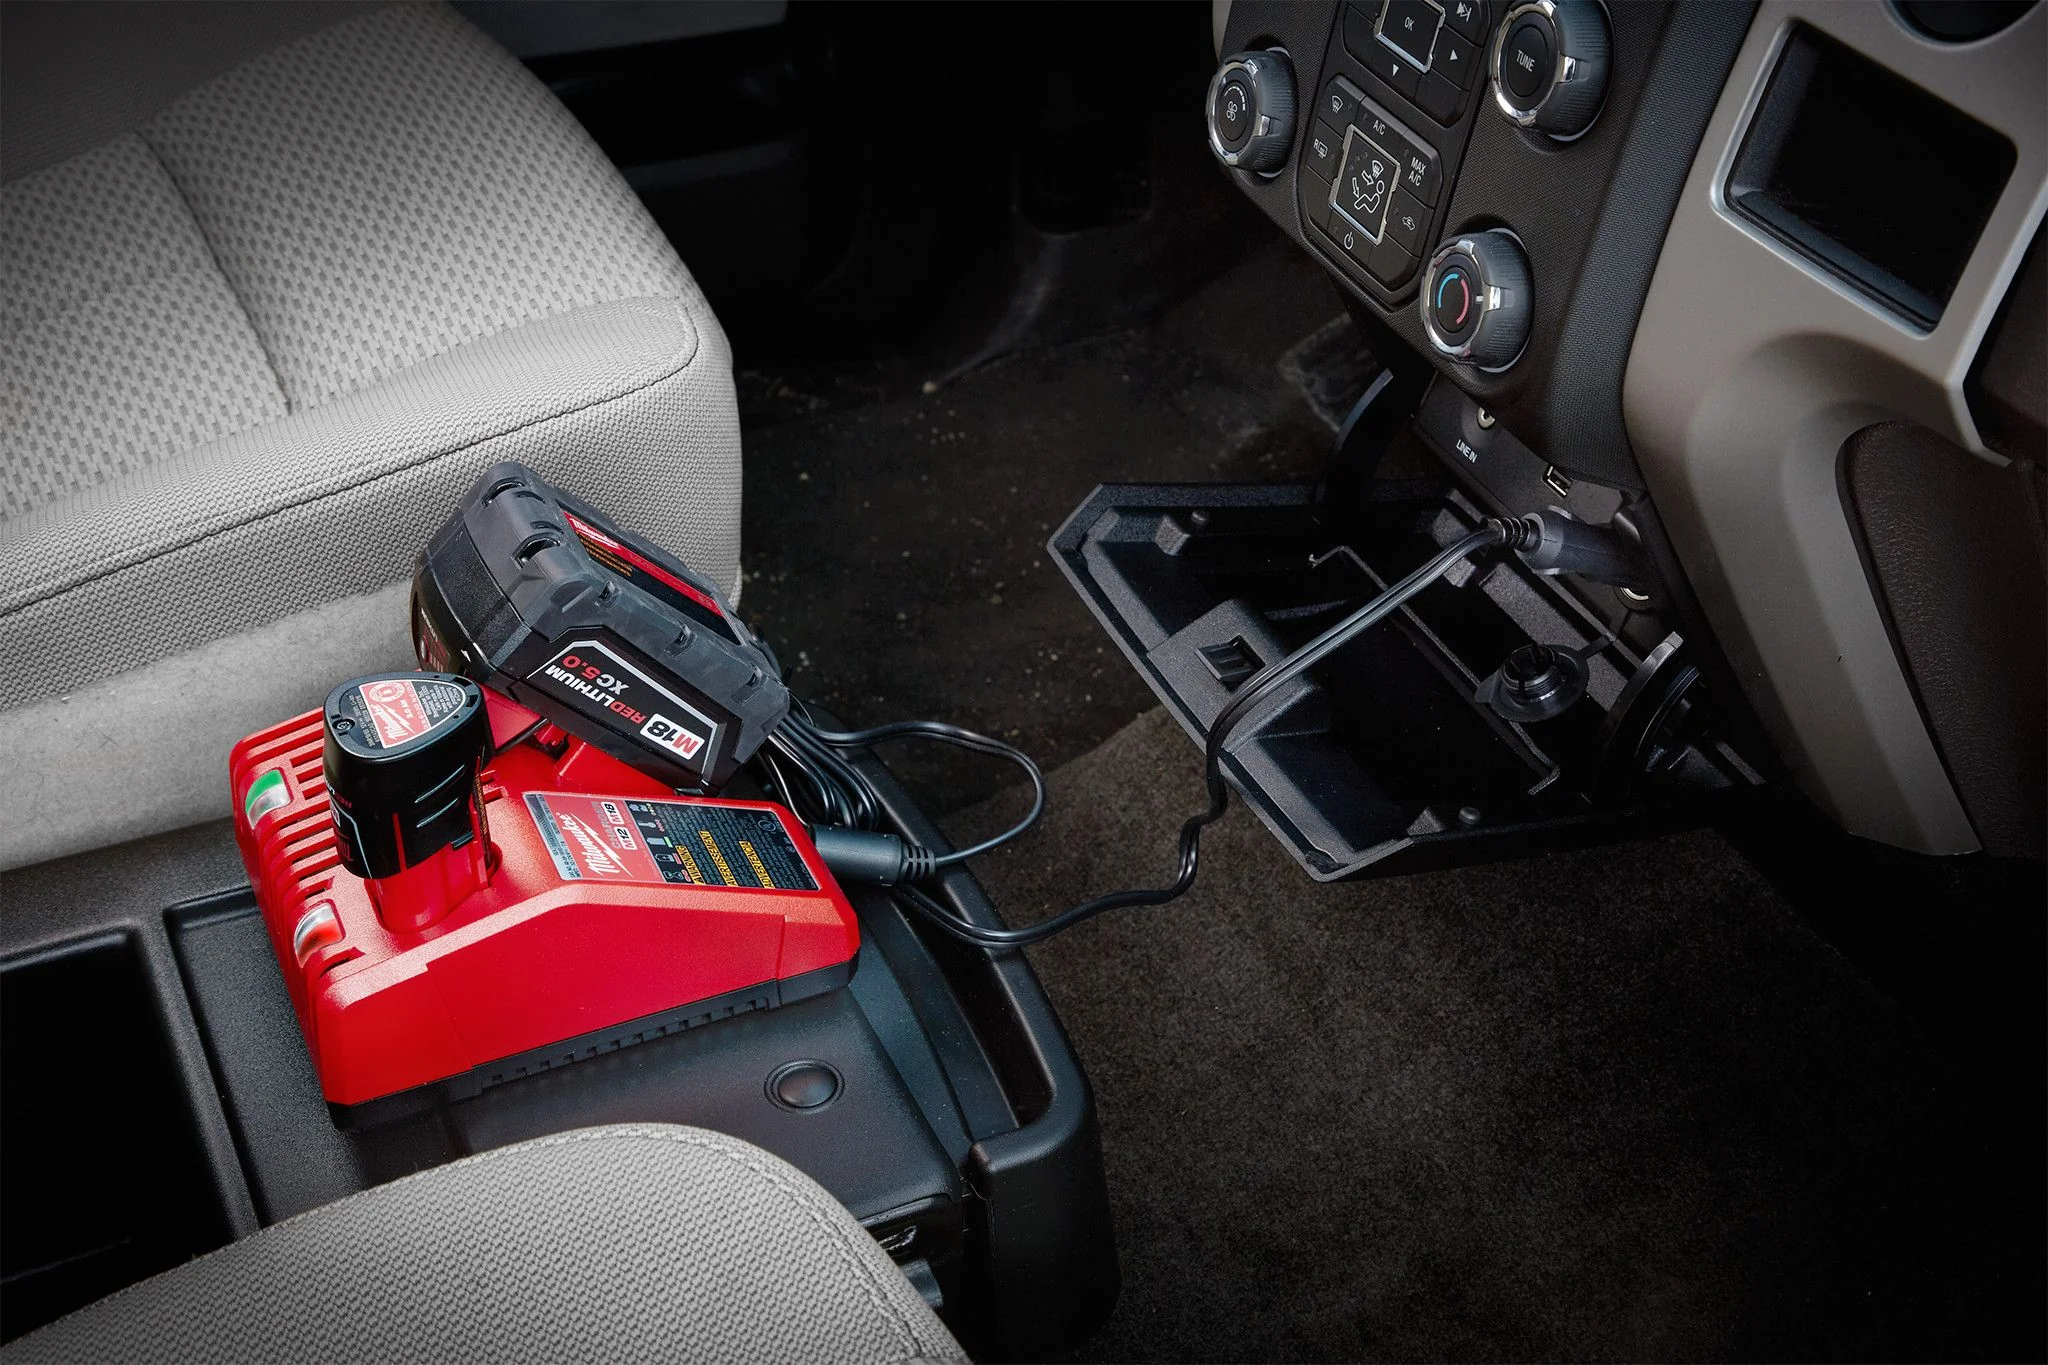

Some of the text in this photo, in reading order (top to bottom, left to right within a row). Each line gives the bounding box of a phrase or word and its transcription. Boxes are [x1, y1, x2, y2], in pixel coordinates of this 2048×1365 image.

[1404, 16, 1415, 31] OK
[1516, 50, 1536, 72] TUNE
[1372, 120, 1386, 135] A/C
[1410, 157, 1427, 175] MAX
[1408, 171, 1422, 186] A/C
[1456, 439, 1478, 463] LINE IN
[562, 655, 629, 695] XC5.0
[545, 664, 699, 754] M18 REDLITHIUM
[603, 803, 635, 849] M12 M18
[558, 813, 621, 877] Milwaukee
[676, 845, 702, 882] WARNING
